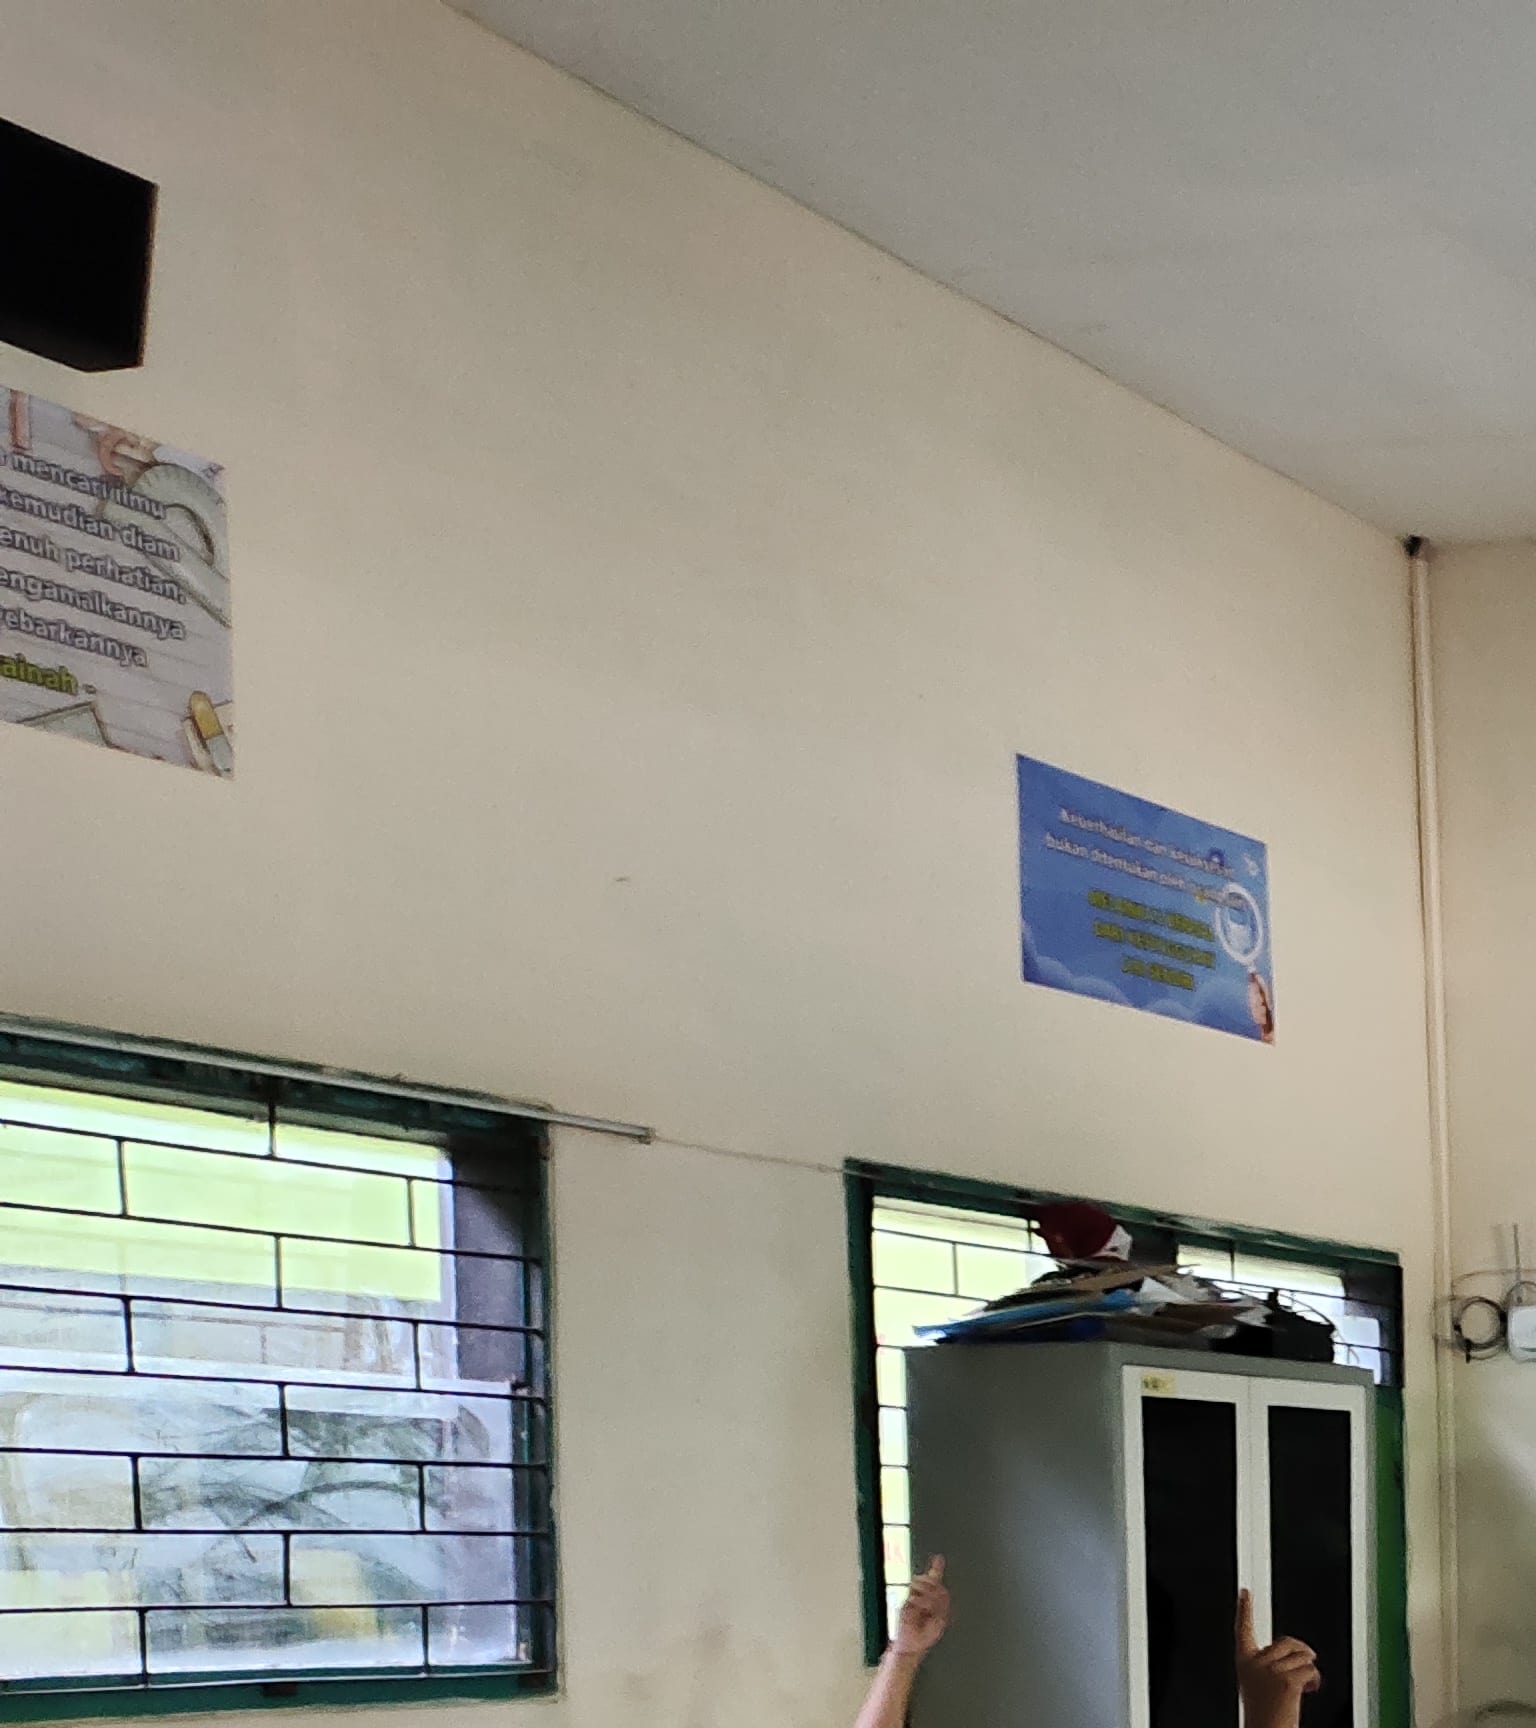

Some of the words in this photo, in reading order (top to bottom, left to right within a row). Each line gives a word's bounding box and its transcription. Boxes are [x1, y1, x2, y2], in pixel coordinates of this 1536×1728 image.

[12, 453, 108, 498] mencari
[111, 484, 167, 520] ilmu
[120, 523, 180, 562] diam
[66, 551, 187, 604] perhatian.
